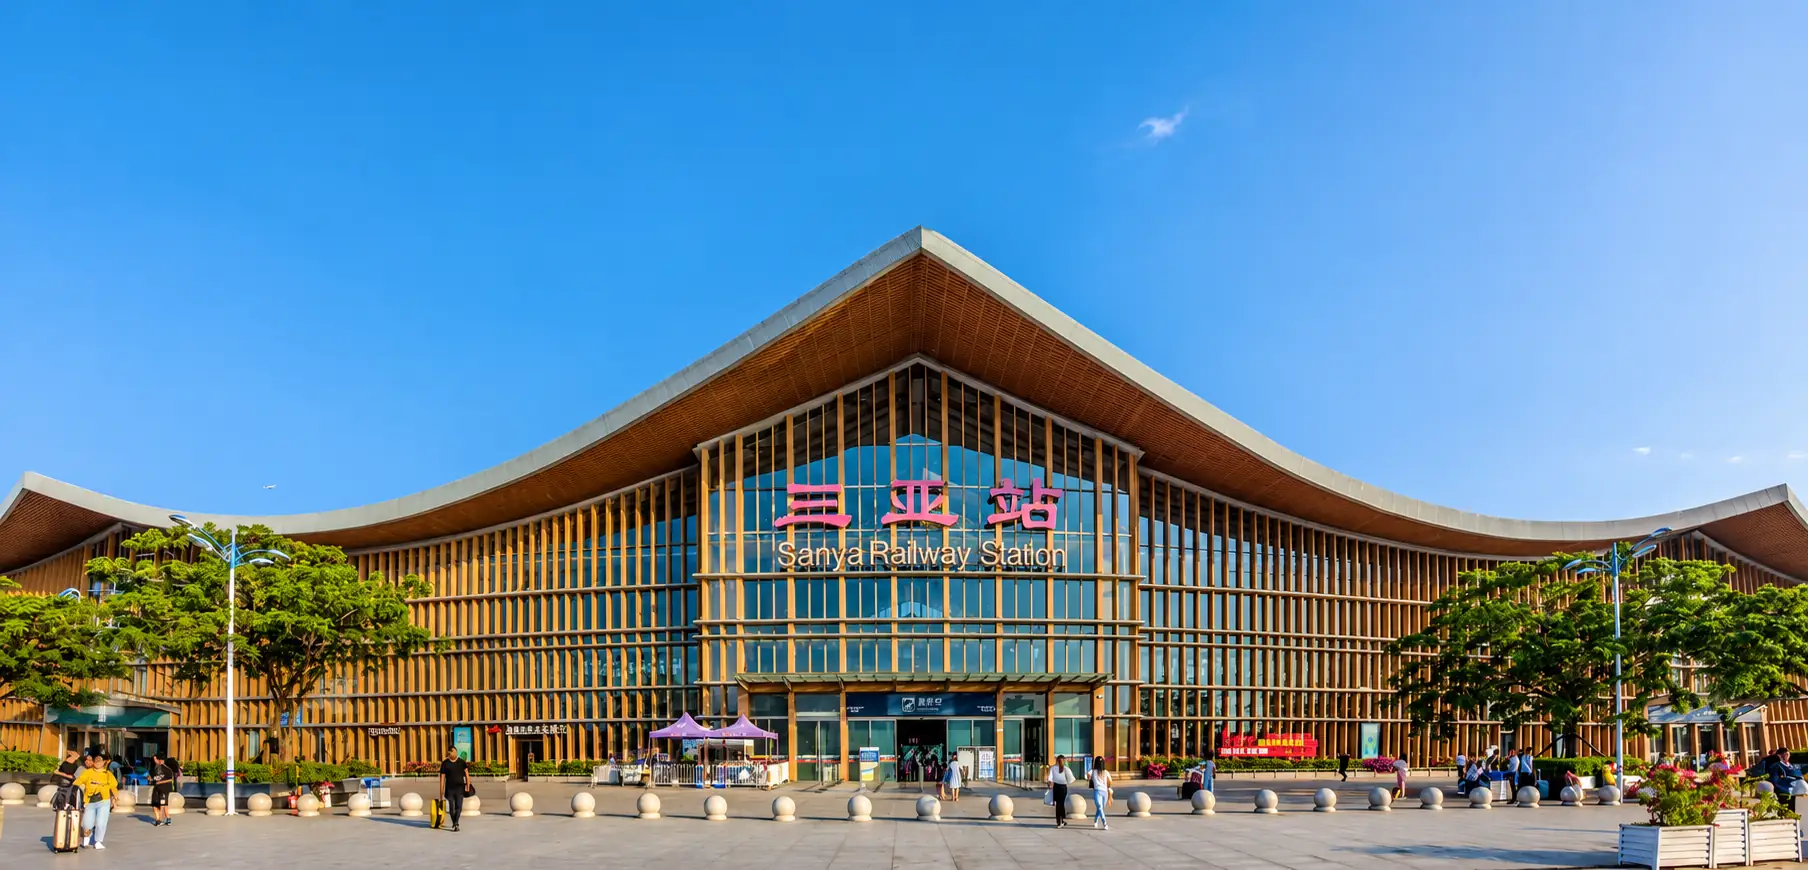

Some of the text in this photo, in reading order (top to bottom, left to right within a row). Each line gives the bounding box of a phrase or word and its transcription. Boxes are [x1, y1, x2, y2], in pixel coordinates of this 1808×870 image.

[773, 477, 1063, 530] 三亚站
[777, 539, 1067, 571] Sanya Railway Station
